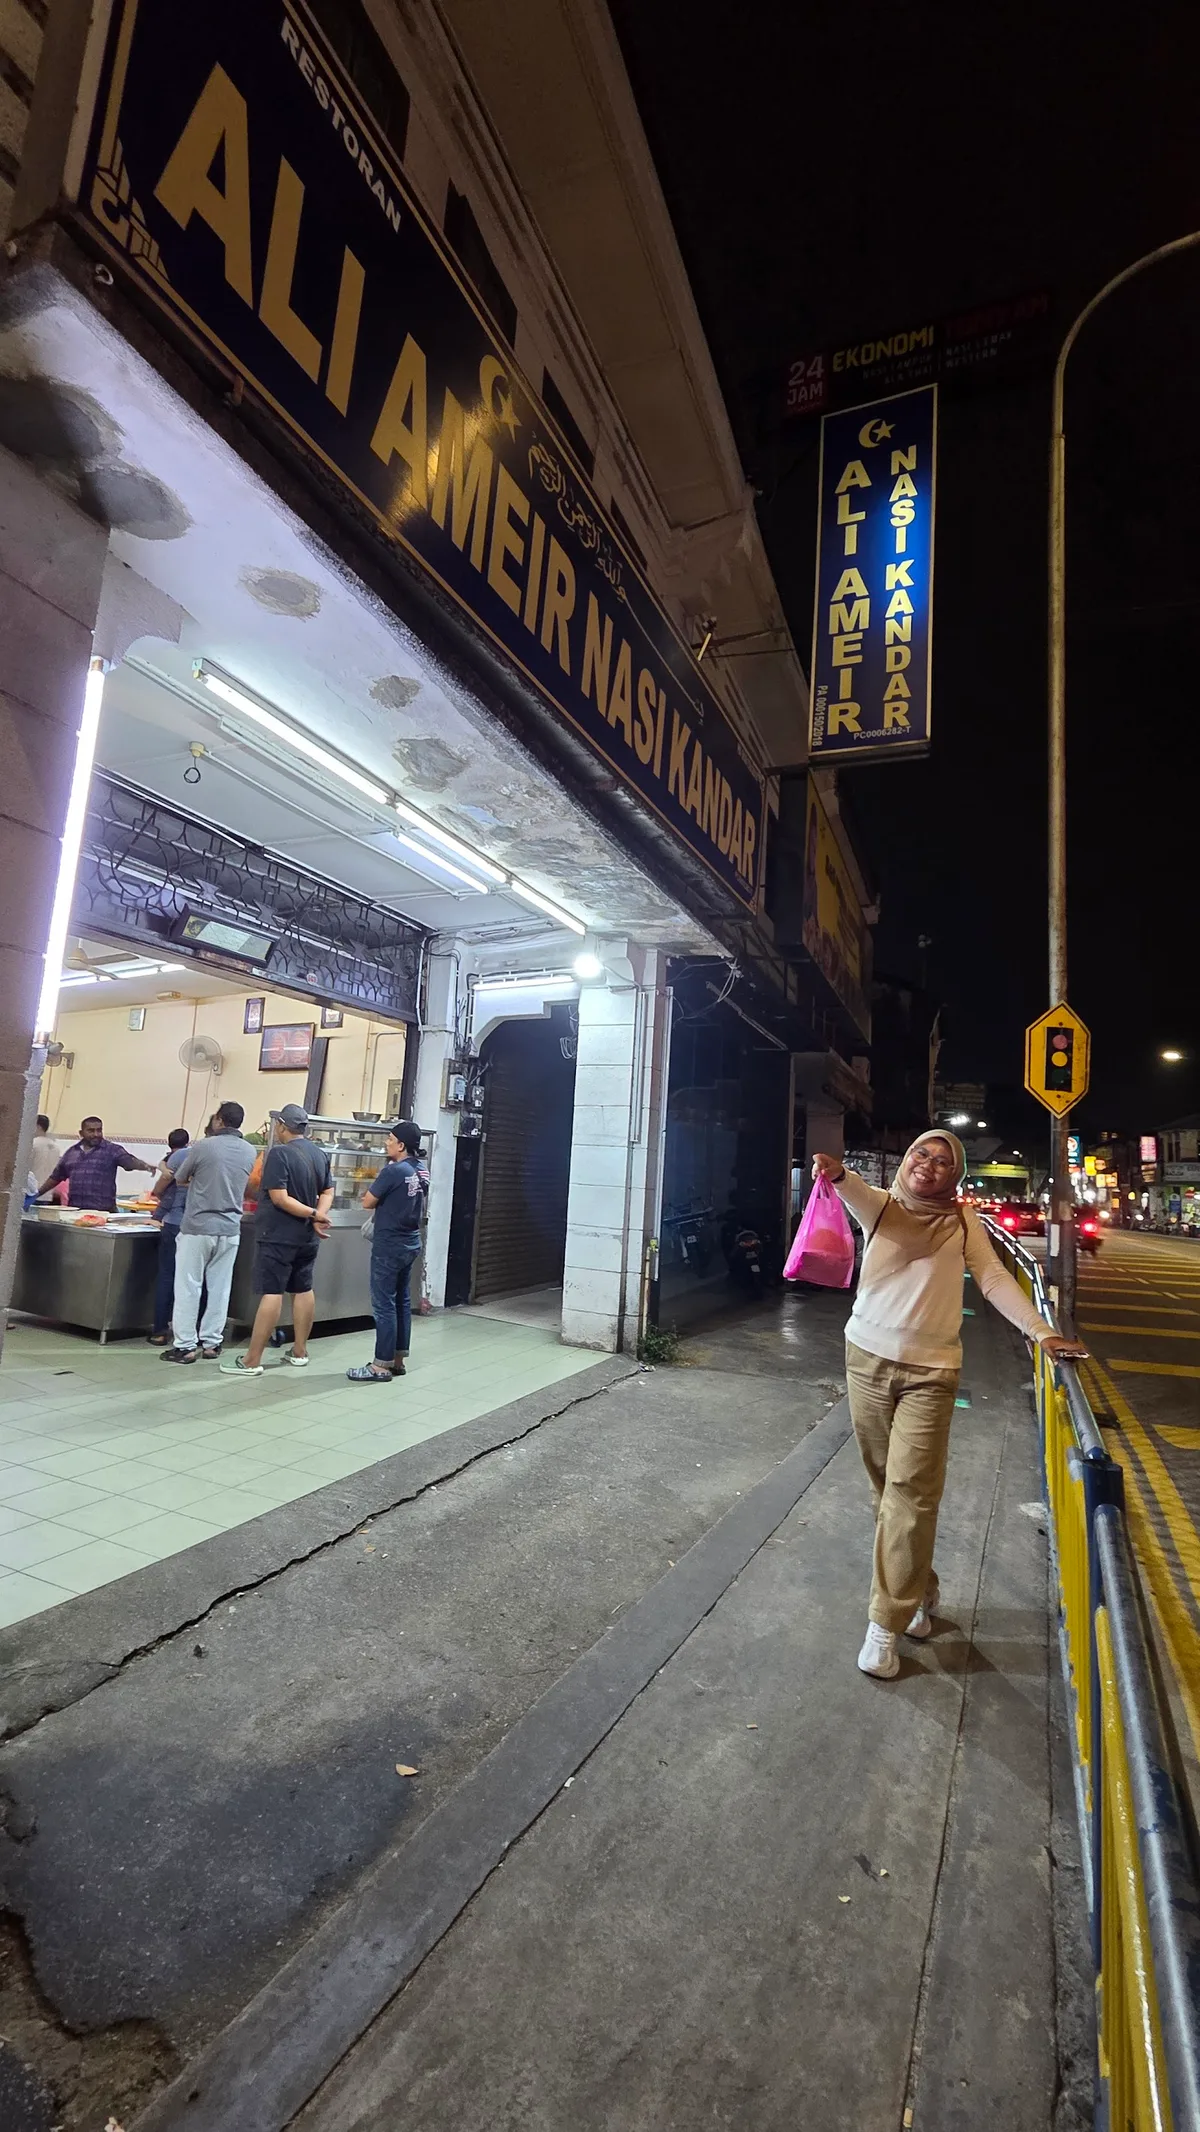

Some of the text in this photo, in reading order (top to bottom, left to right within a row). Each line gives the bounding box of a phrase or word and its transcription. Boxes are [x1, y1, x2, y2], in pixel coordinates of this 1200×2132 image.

[281, 16, 401, 234] RESTORAN
[787, 381, 823, 405] JAM
[788, 354, 825, 387] 24
[832, 325, 935, 373] EKONOMI
[153, 61, 757, 886] ALI AMEIR NASI KANDAR
[828, 460, 872, 735] ALI AMEIR
[884, 444, 918, 728] NASI KANDAR
[817, 685, 828, 696] PA
